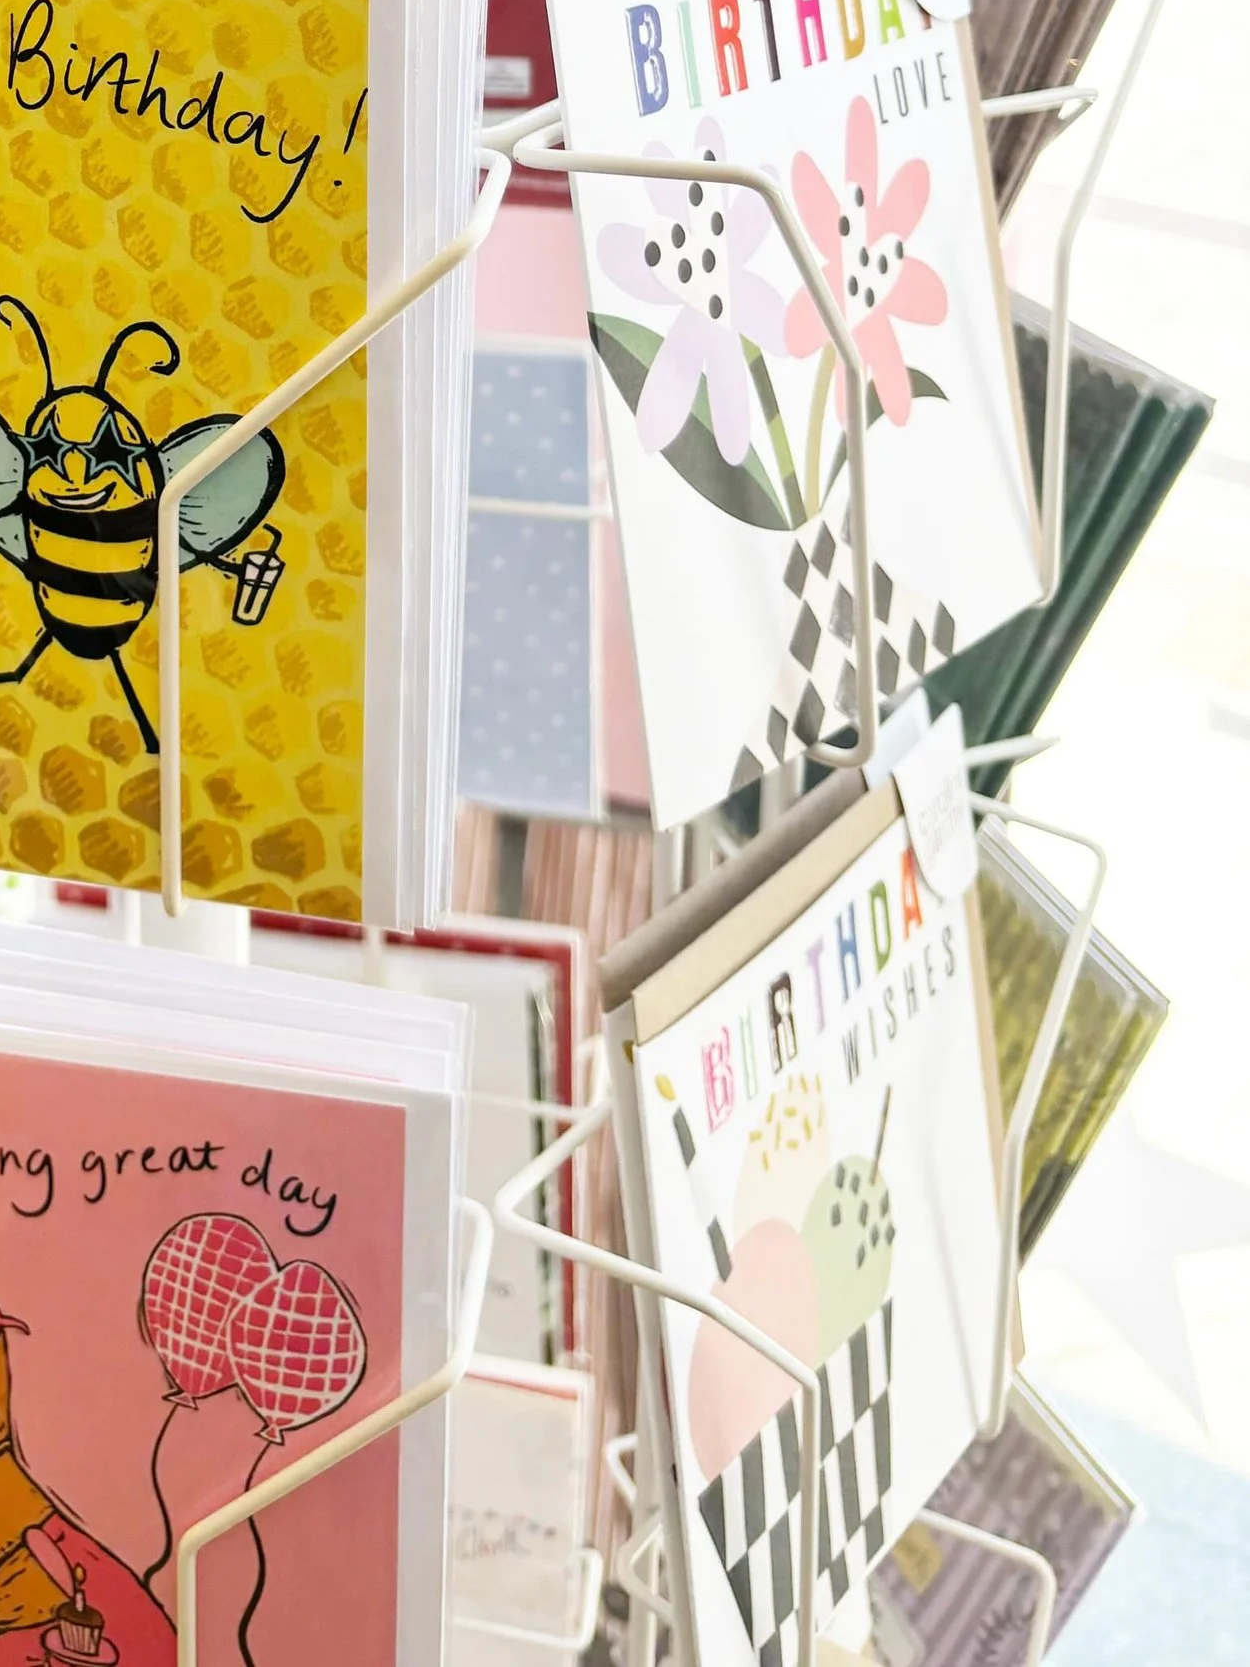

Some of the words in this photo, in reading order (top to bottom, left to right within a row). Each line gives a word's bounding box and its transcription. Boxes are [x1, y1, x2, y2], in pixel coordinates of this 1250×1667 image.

[873, 51, 951, 124] LOVE
[701, 846, 923, 1135] BIRTHDA
[841, 925, 956, 1084] WISHES
[81, 1139, 225, 1204] great
[241, 1149, 338, 1237] day
